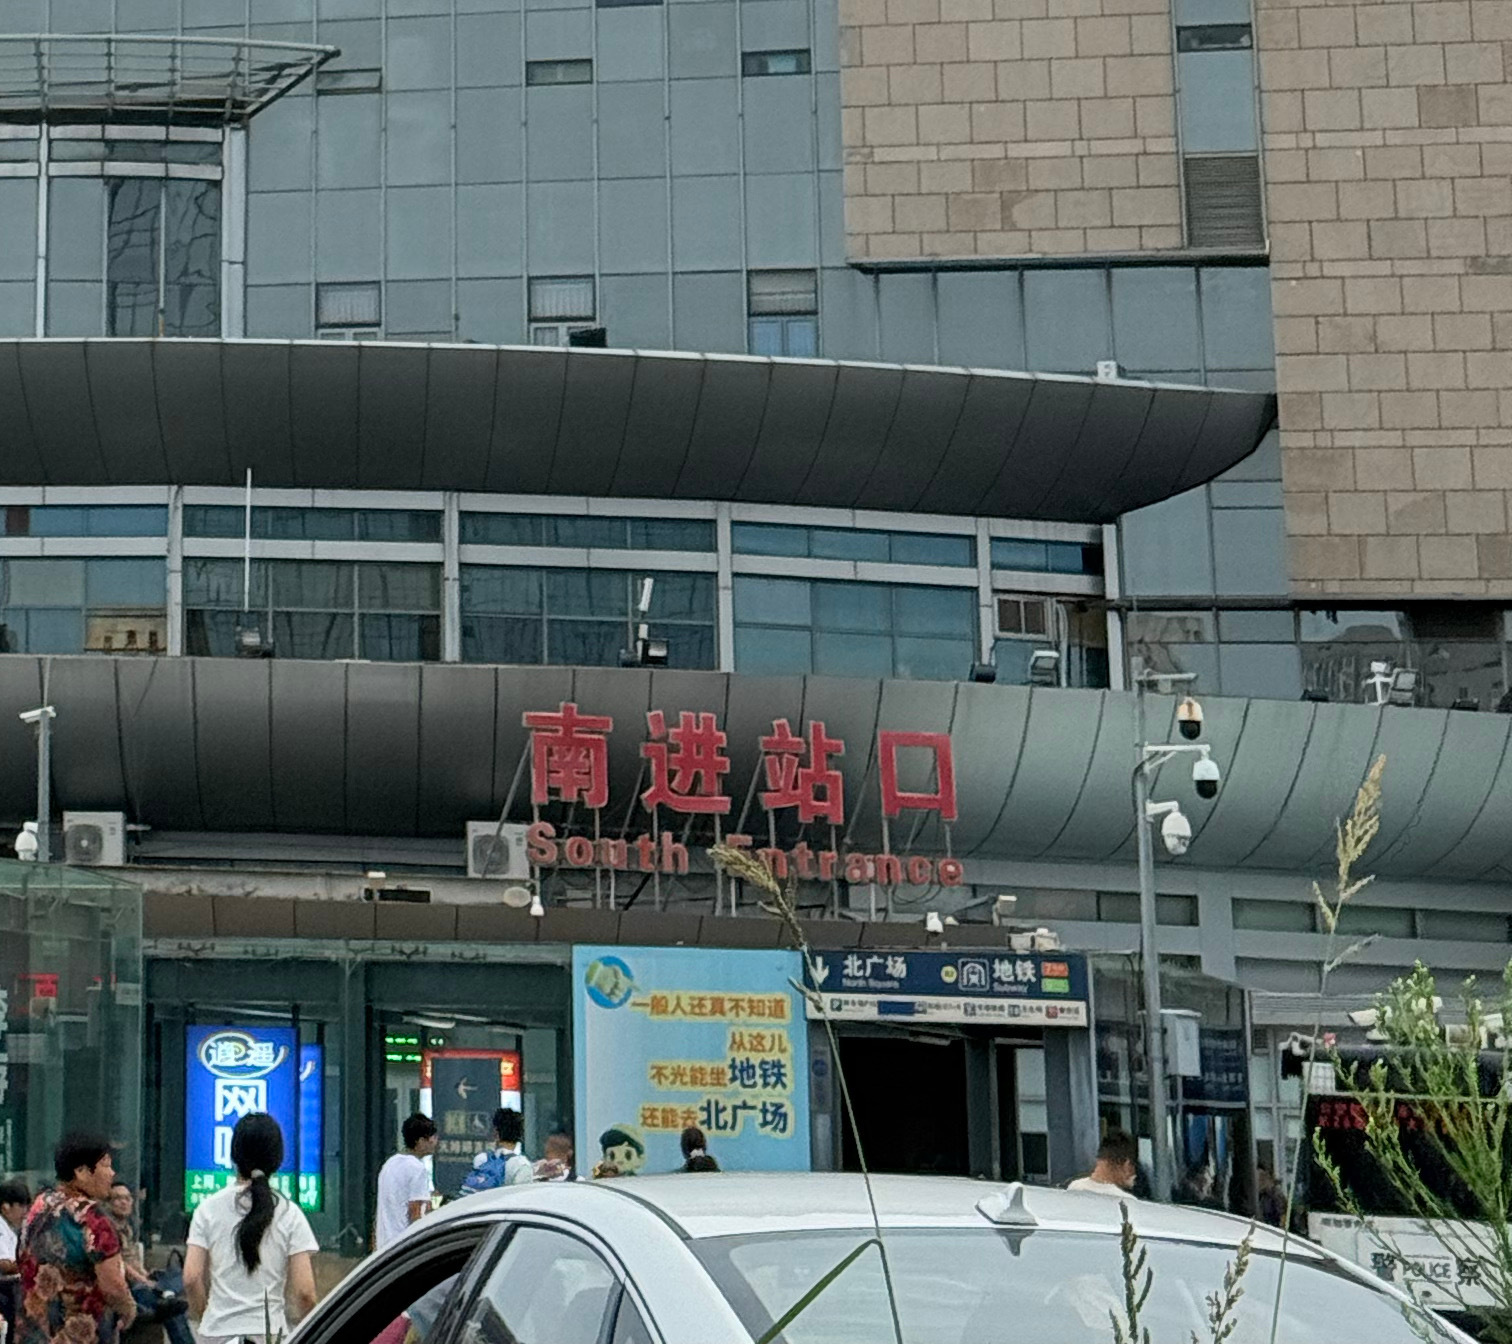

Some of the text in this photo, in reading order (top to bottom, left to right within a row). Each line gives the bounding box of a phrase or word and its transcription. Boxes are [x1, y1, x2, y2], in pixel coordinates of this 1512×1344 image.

[522, 702, 957, 825] 南进站口
[526, 821, 689, 873] South
[843, 954, 907, 979] 北广场
[992, 958, 1036, 983] 地铁
[631, 995, 786, 1019] 一般人还真不知道
[729, 1031, 787, 1054] 从这儿
[650, 1057, 787, 1089] 不光能坐地铁
[641, 1099, 787, 1133] 还能去北广场
[1403, 1261, 1451, 1279] POLICE
